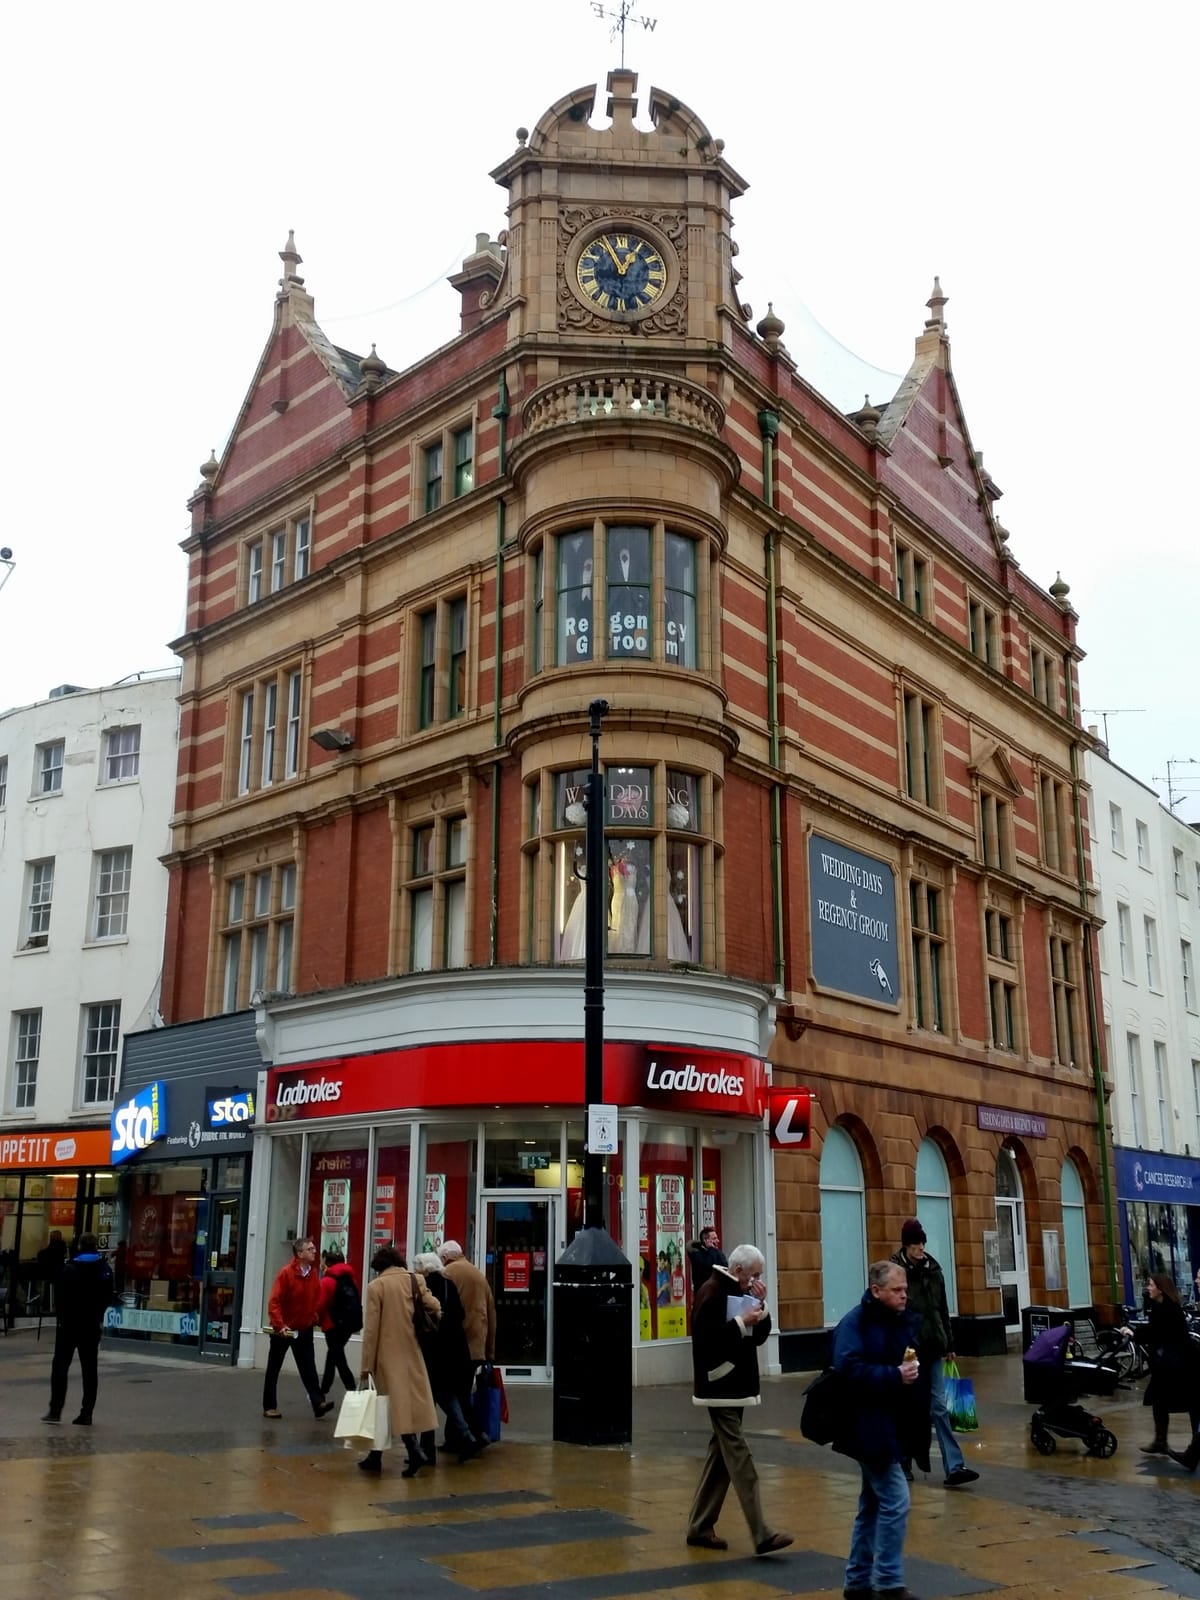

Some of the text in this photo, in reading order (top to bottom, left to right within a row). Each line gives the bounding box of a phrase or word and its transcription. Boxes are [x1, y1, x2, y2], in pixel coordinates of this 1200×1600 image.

[641, 15, 658, 32] W
[611, 805, 649, 819] DAYS
[821, 853, 883, 895] WEDDING DAYS
[850, 889, 857, 908] &
[817, 899, 889, 942] REGENCY GROOM
[276, 1077, 343, 1106] Ladbrokes
[647, 1062, 744, 1096] Ladbrokes
[211, 1097, 249, 1122] sta
[112, 1098, 153, 1151] sta
[0, 1136, 50, 1163] PPÉTIT
[1144, 1171, 1163, 1186] CANCER
[1164, 1173, 1186, 1188] RESEARCH
